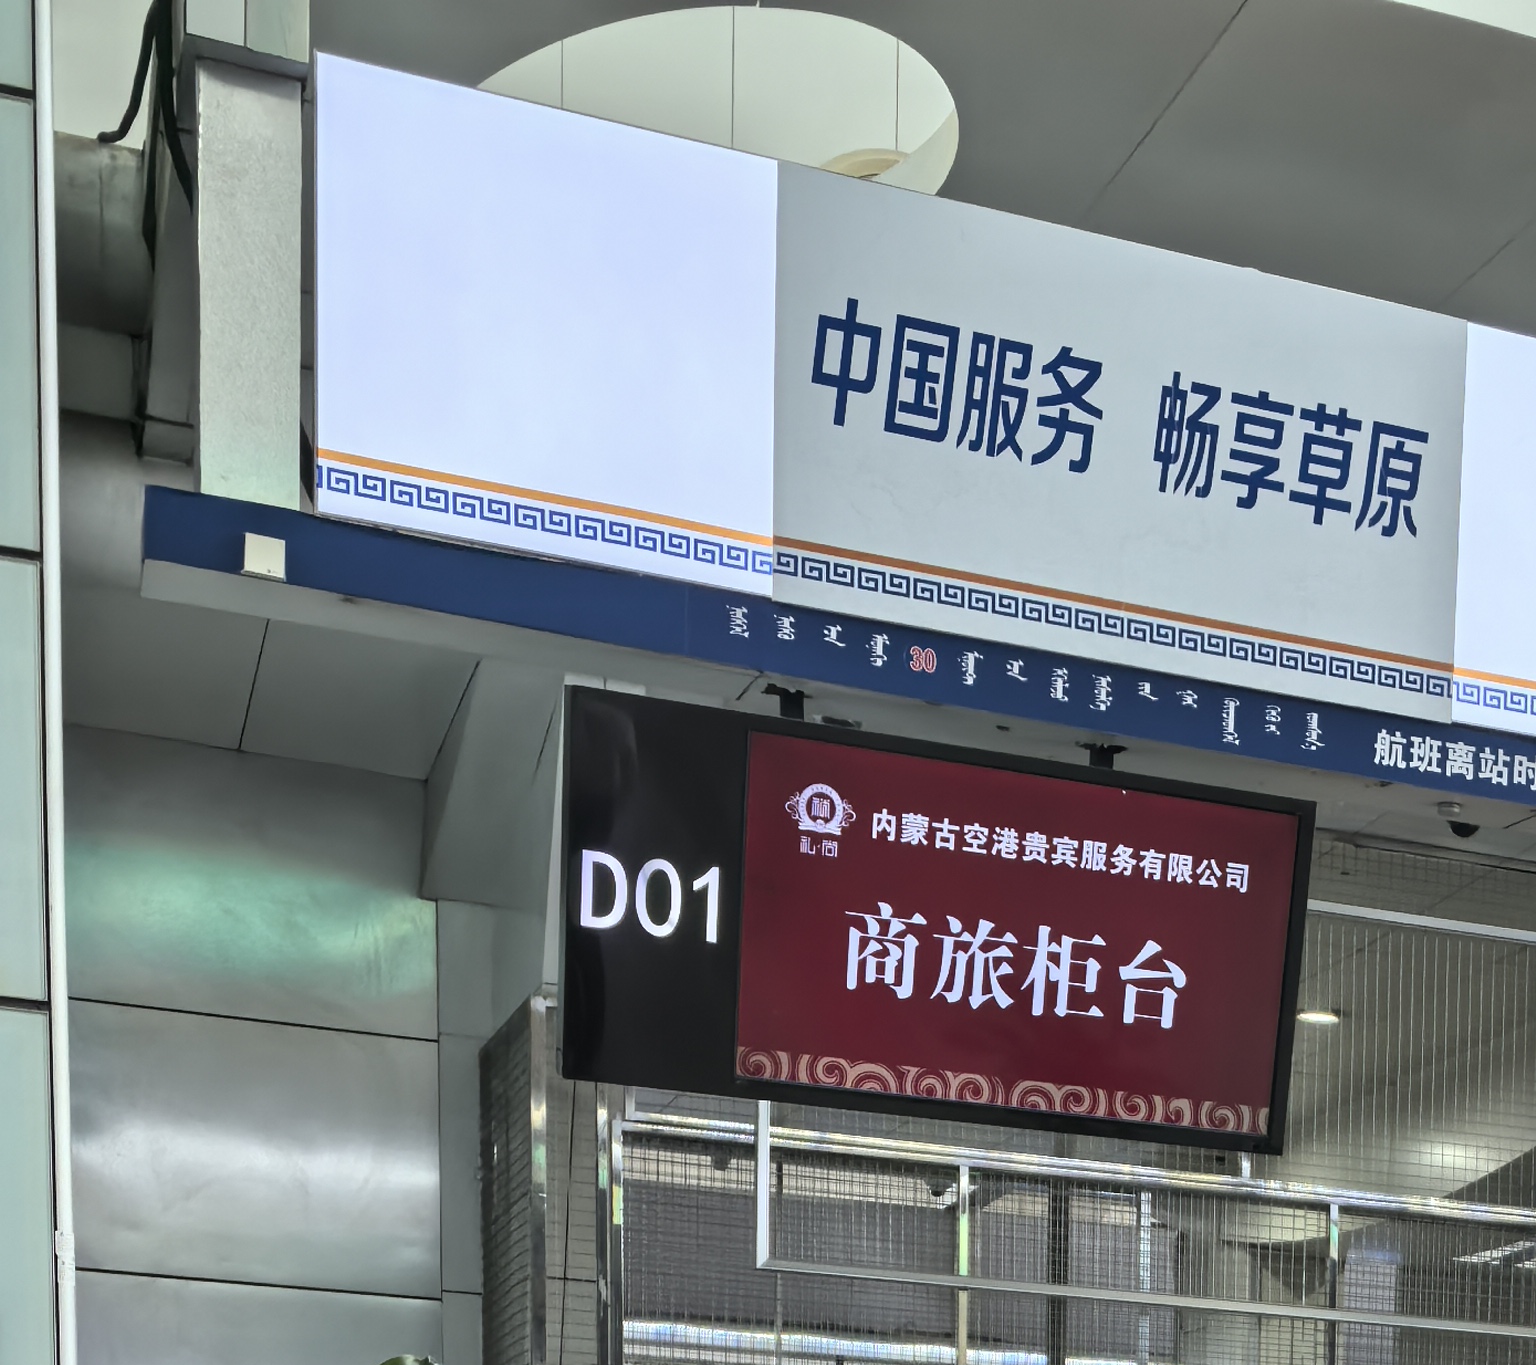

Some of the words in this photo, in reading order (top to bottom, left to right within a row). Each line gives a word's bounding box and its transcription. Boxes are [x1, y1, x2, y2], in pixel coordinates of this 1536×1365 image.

[811, 298, 1104, 475] 中国服务
[1152, 371, 1430, 539] 畅享草原
[909, 645, 937, 674] 30
[578, 849, 720, 944] D01
[871, 808, 1251, 893] 内蒙古空港贵宾服务有限公司
[843, 901, 1188, 1030] 商旅柜台
